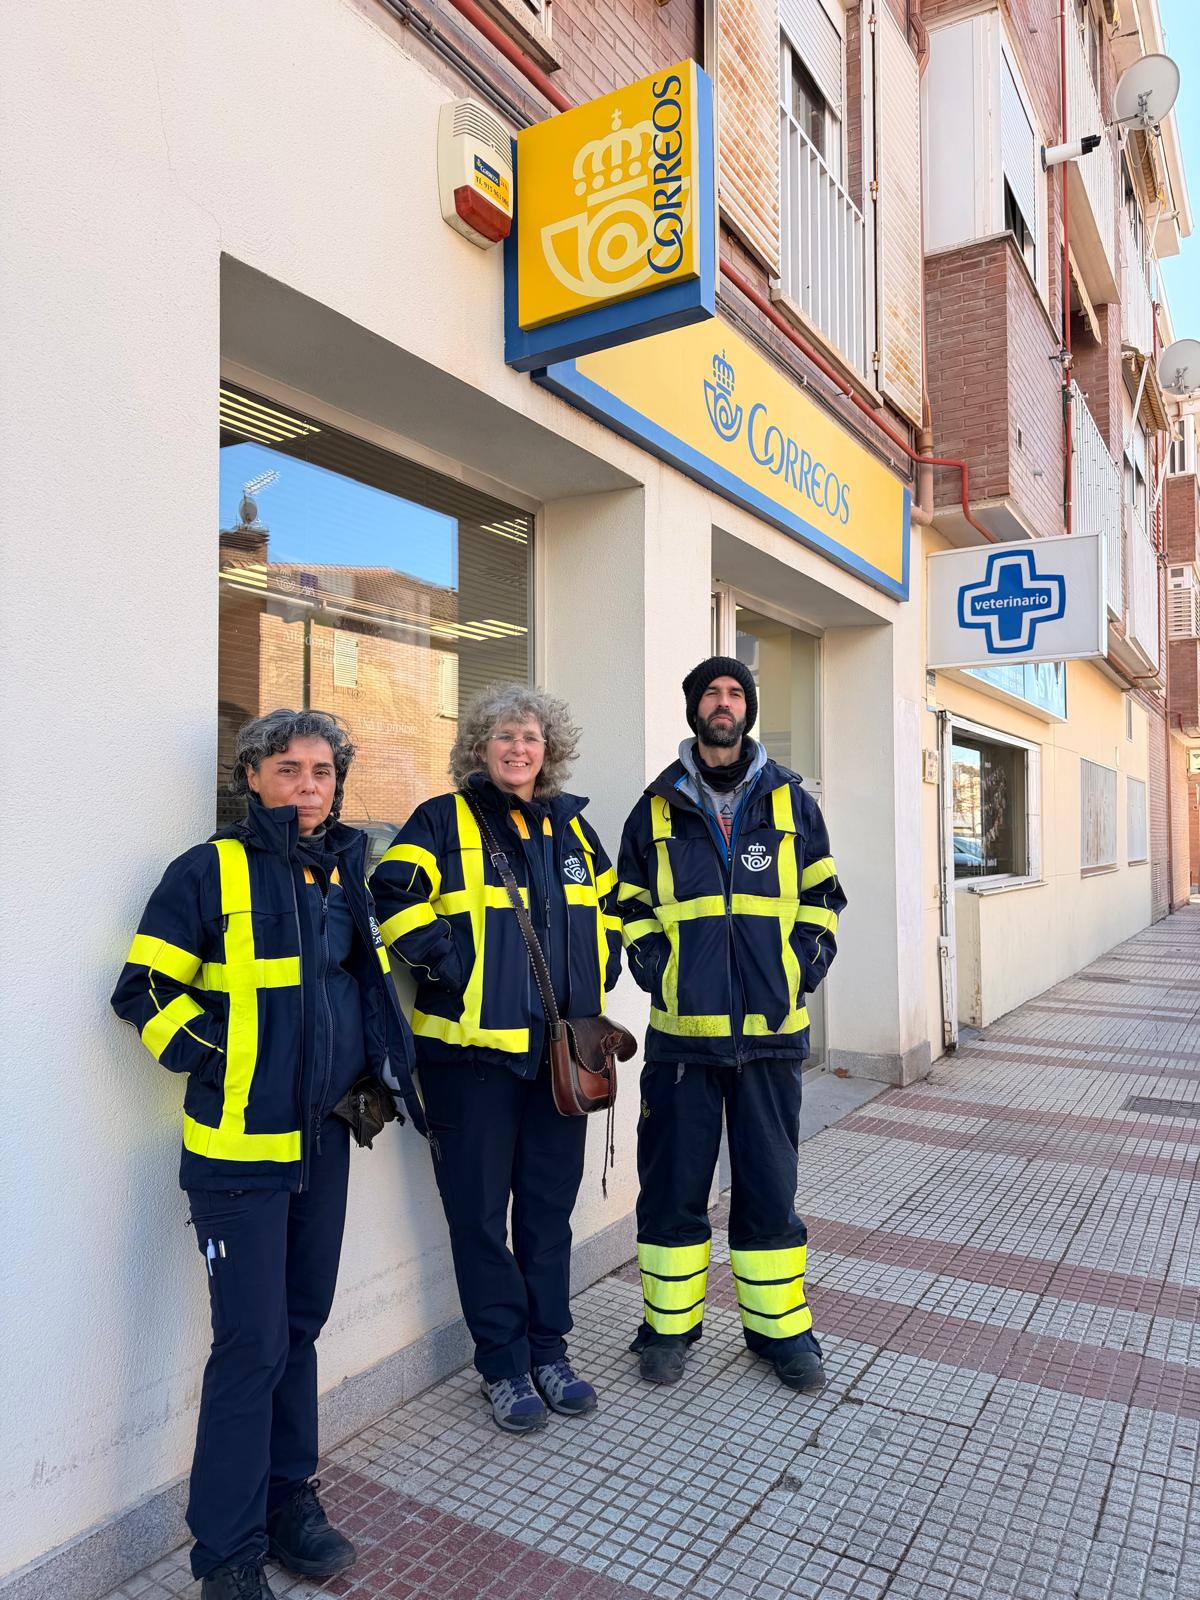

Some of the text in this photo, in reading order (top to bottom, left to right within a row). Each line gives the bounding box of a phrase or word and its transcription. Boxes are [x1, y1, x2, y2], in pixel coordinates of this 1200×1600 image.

[647, 75, 684, 275] CORREOS
[747, 403, 850, 525] CORREOS
[975, 593, 1049, 610] veterinario
